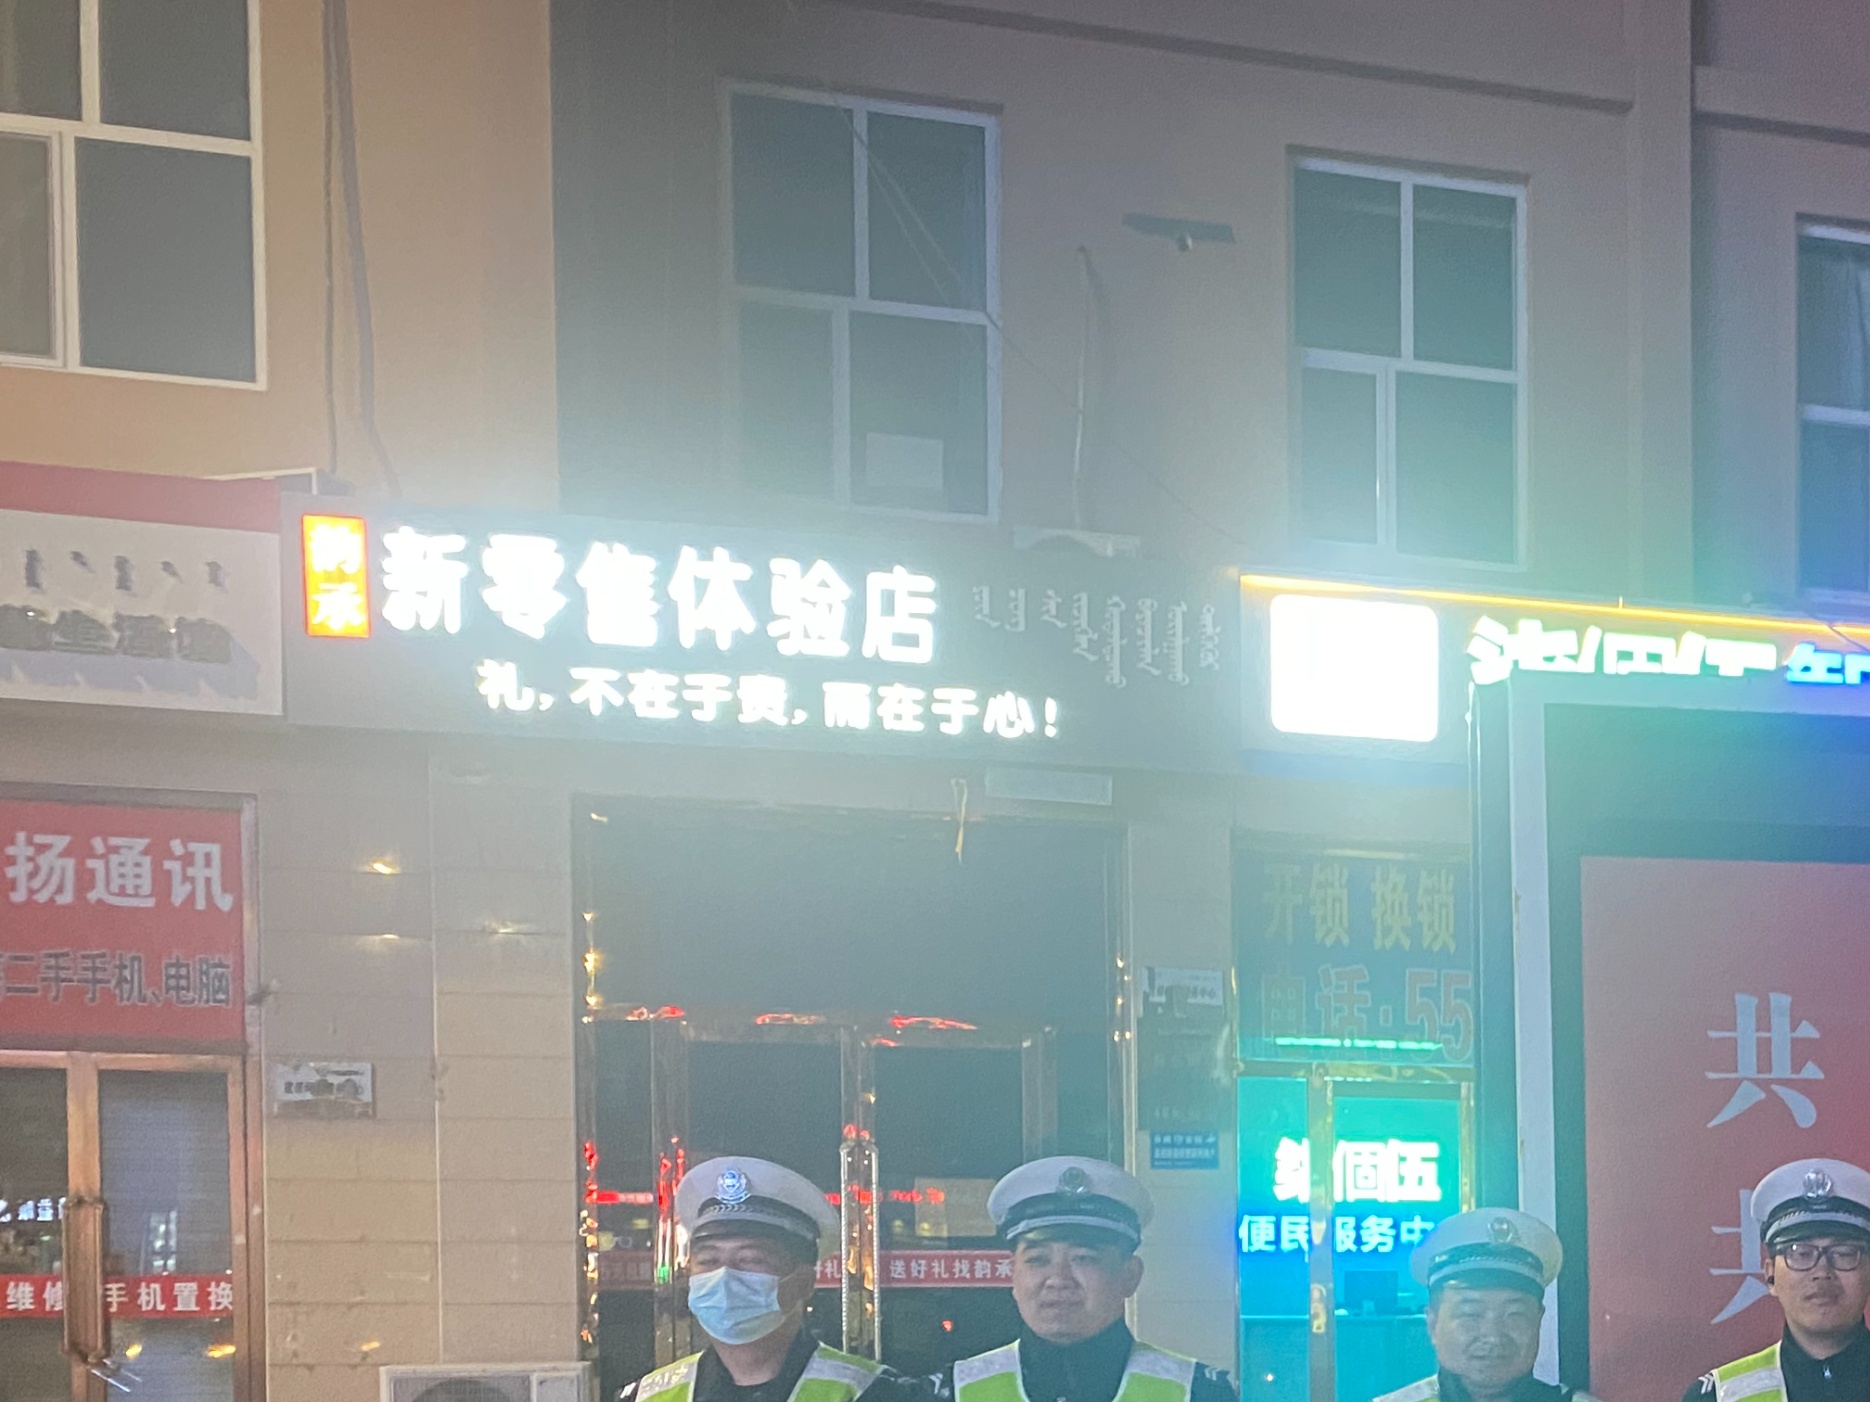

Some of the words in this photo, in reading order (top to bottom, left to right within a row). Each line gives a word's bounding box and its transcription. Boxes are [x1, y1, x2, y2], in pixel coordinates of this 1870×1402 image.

[380, 523, 937, 665] 新零售体验店
[4, 831, 234, 912] 扬通讯
[1262, 862, 1350, 949] 开锁
[1370, 865, 1456, 955] 换锁
[0, 951, 231, 1006] 二手手机、电脑
